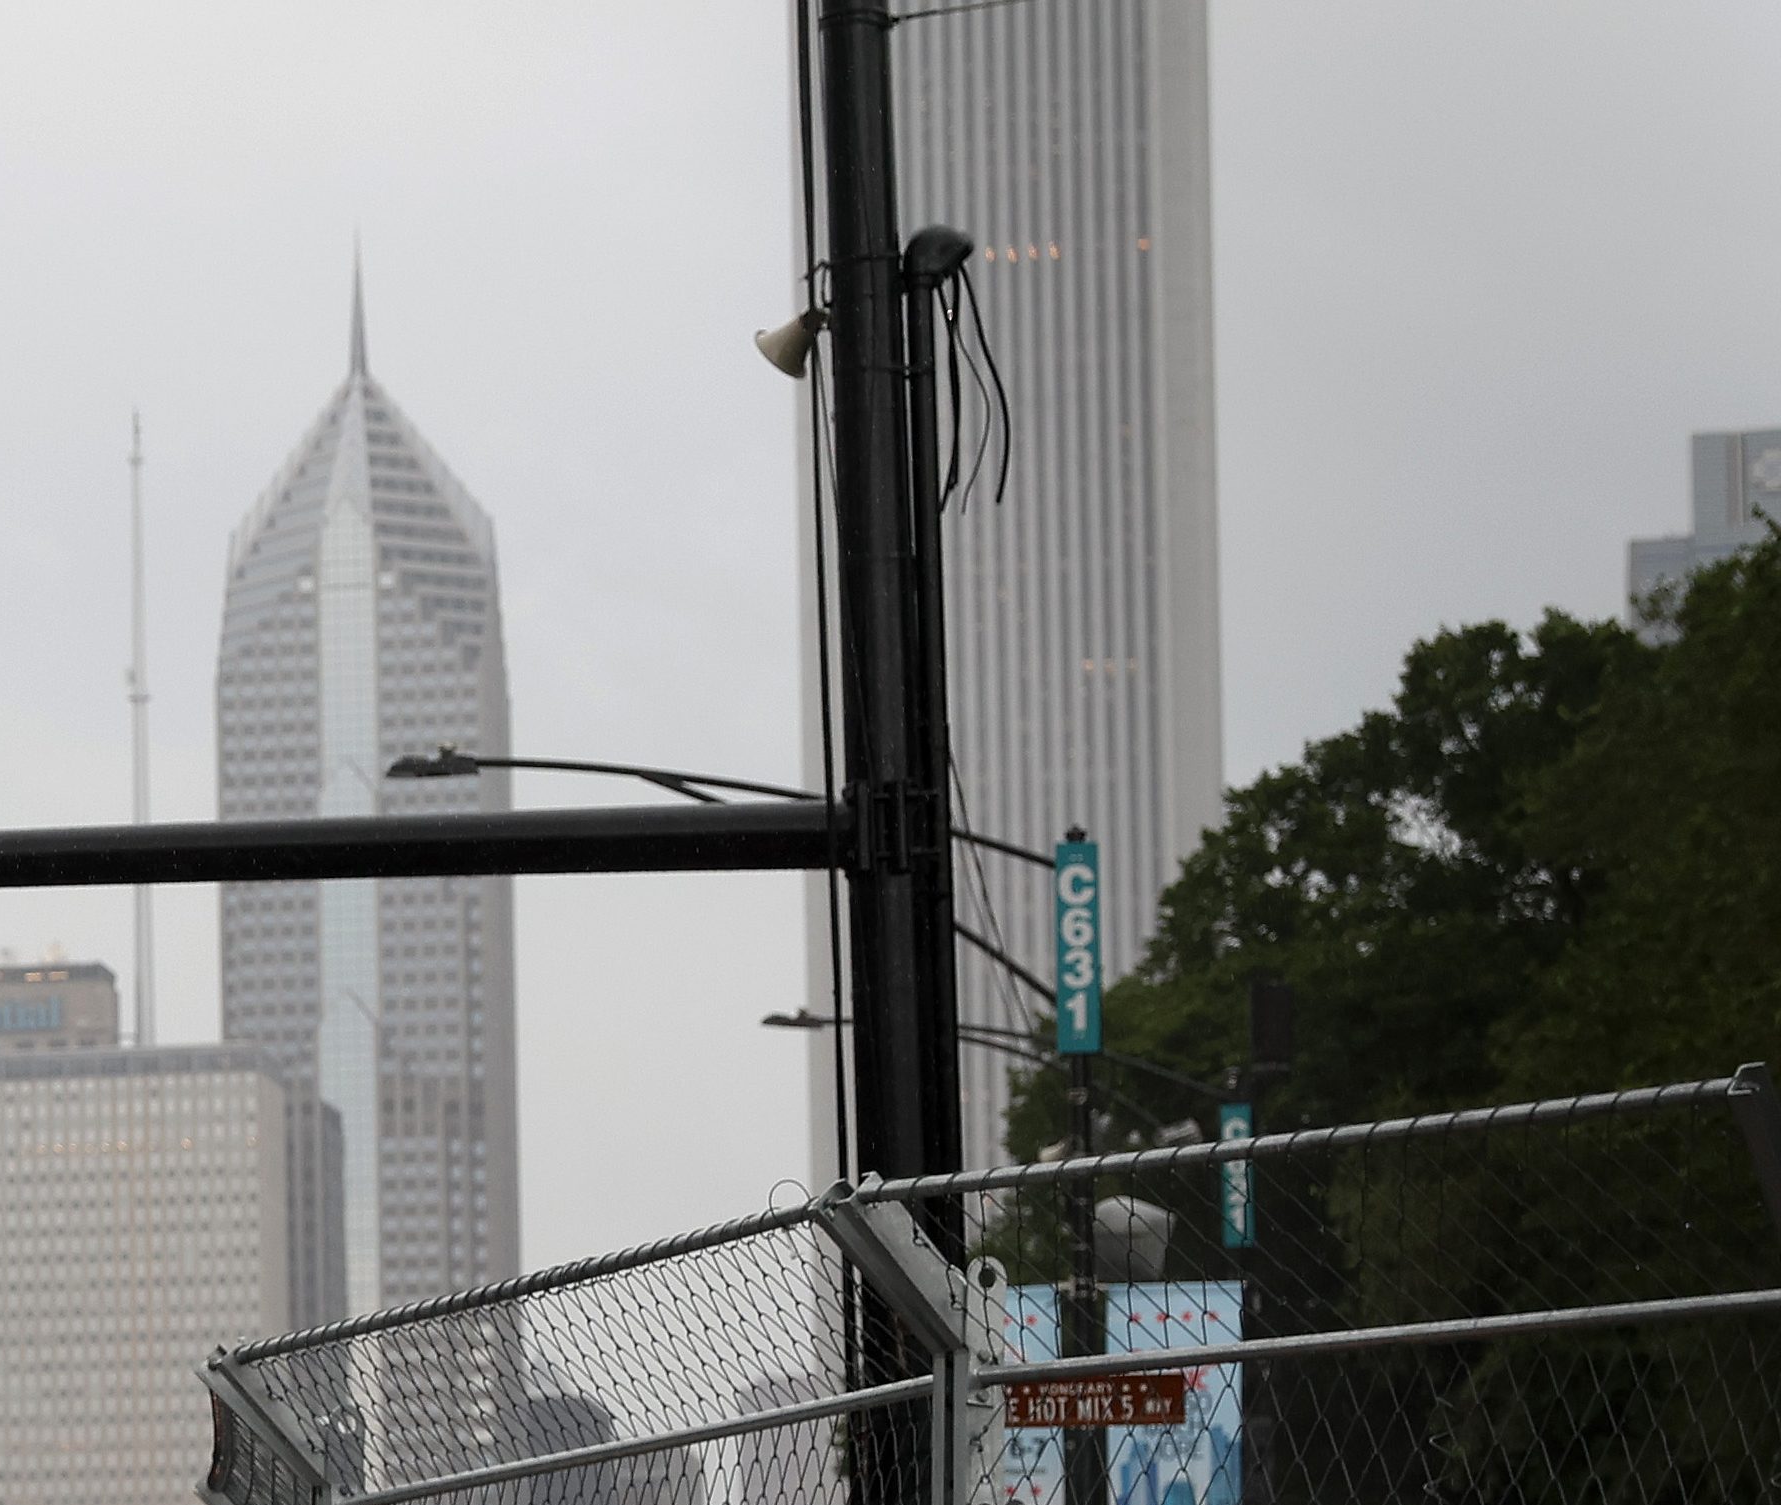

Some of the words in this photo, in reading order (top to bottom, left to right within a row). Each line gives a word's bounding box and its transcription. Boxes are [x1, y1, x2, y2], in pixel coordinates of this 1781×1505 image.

[1058, 865, 1096, 1032] C631
[1028, 1398, 1067, 1422] HOT
[1077, 1396, 1114, 1422] MIX
[1121, 1394, 1134, 1420] 5
